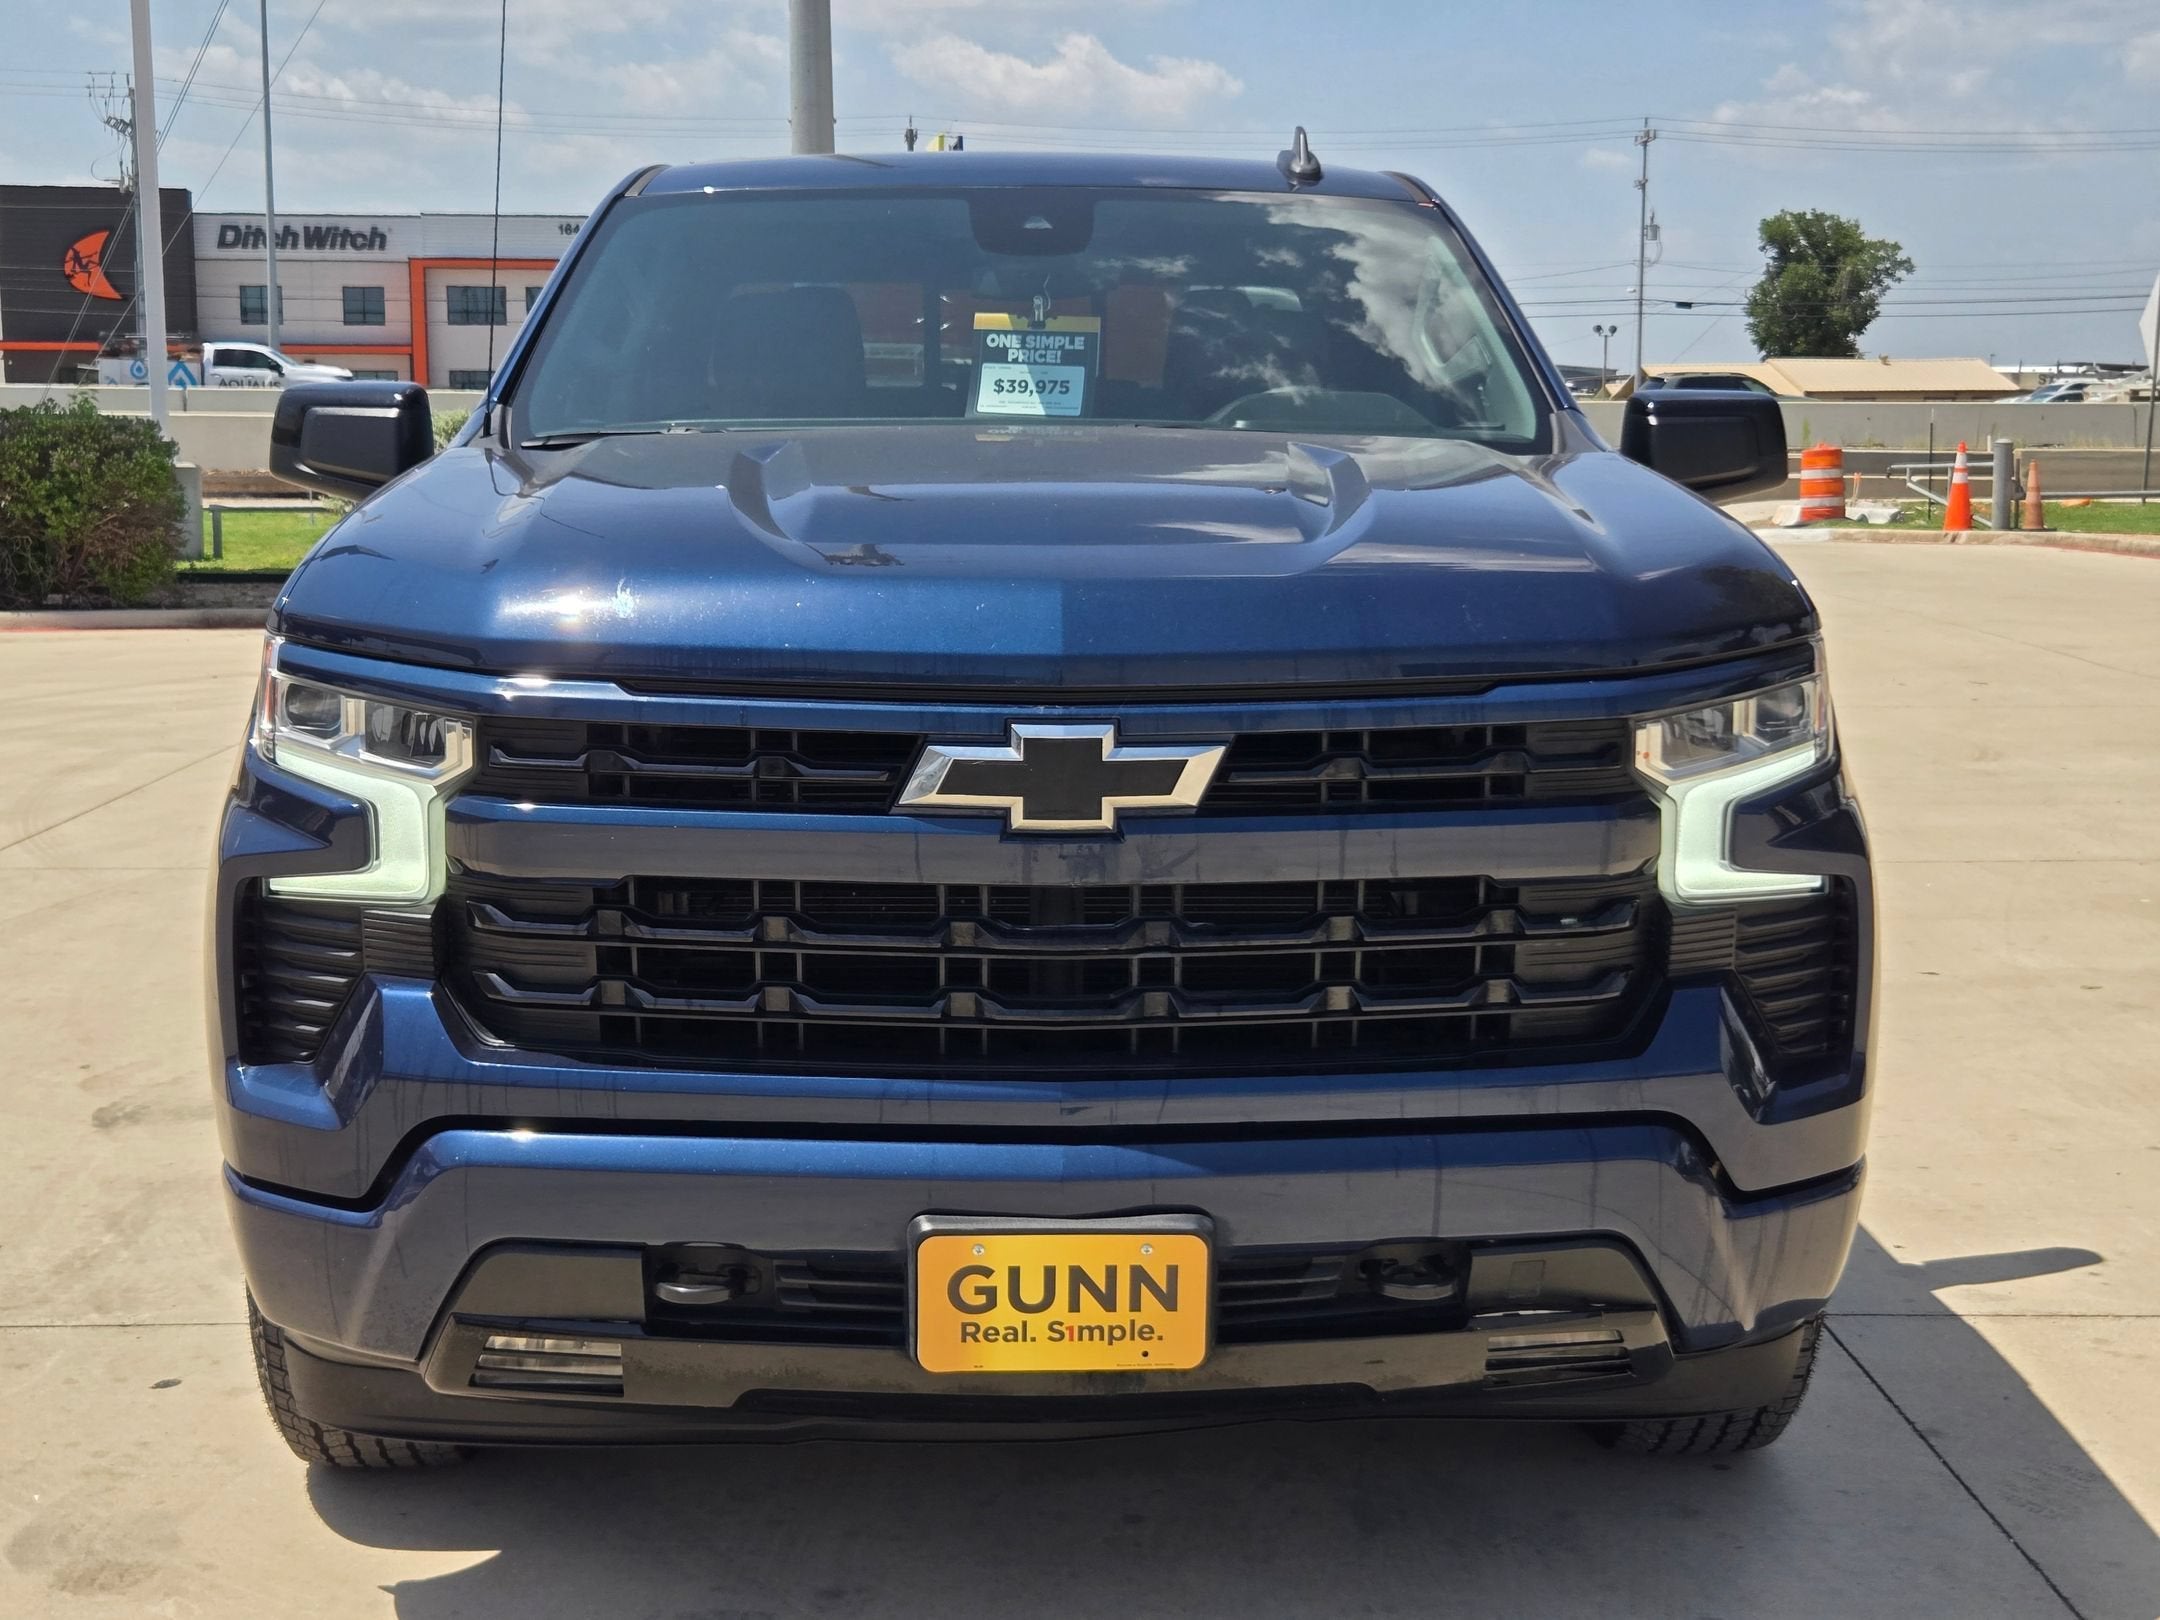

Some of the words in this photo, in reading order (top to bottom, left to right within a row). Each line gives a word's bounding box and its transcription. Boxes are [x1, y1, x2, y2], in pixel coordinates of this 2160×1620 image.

[303, 225, 387, 250] Witch
[986, 333, 1022, 349] ONE
[1025, 335, 1085, 350] SIMPLE
[1007, 348, 1062, 364] PRICE!
[993, 378, 1070, 397] $39,975
[947, 1264, 1178, 1314] GUNN
[960, 1320, 1036, 1343] Real.
